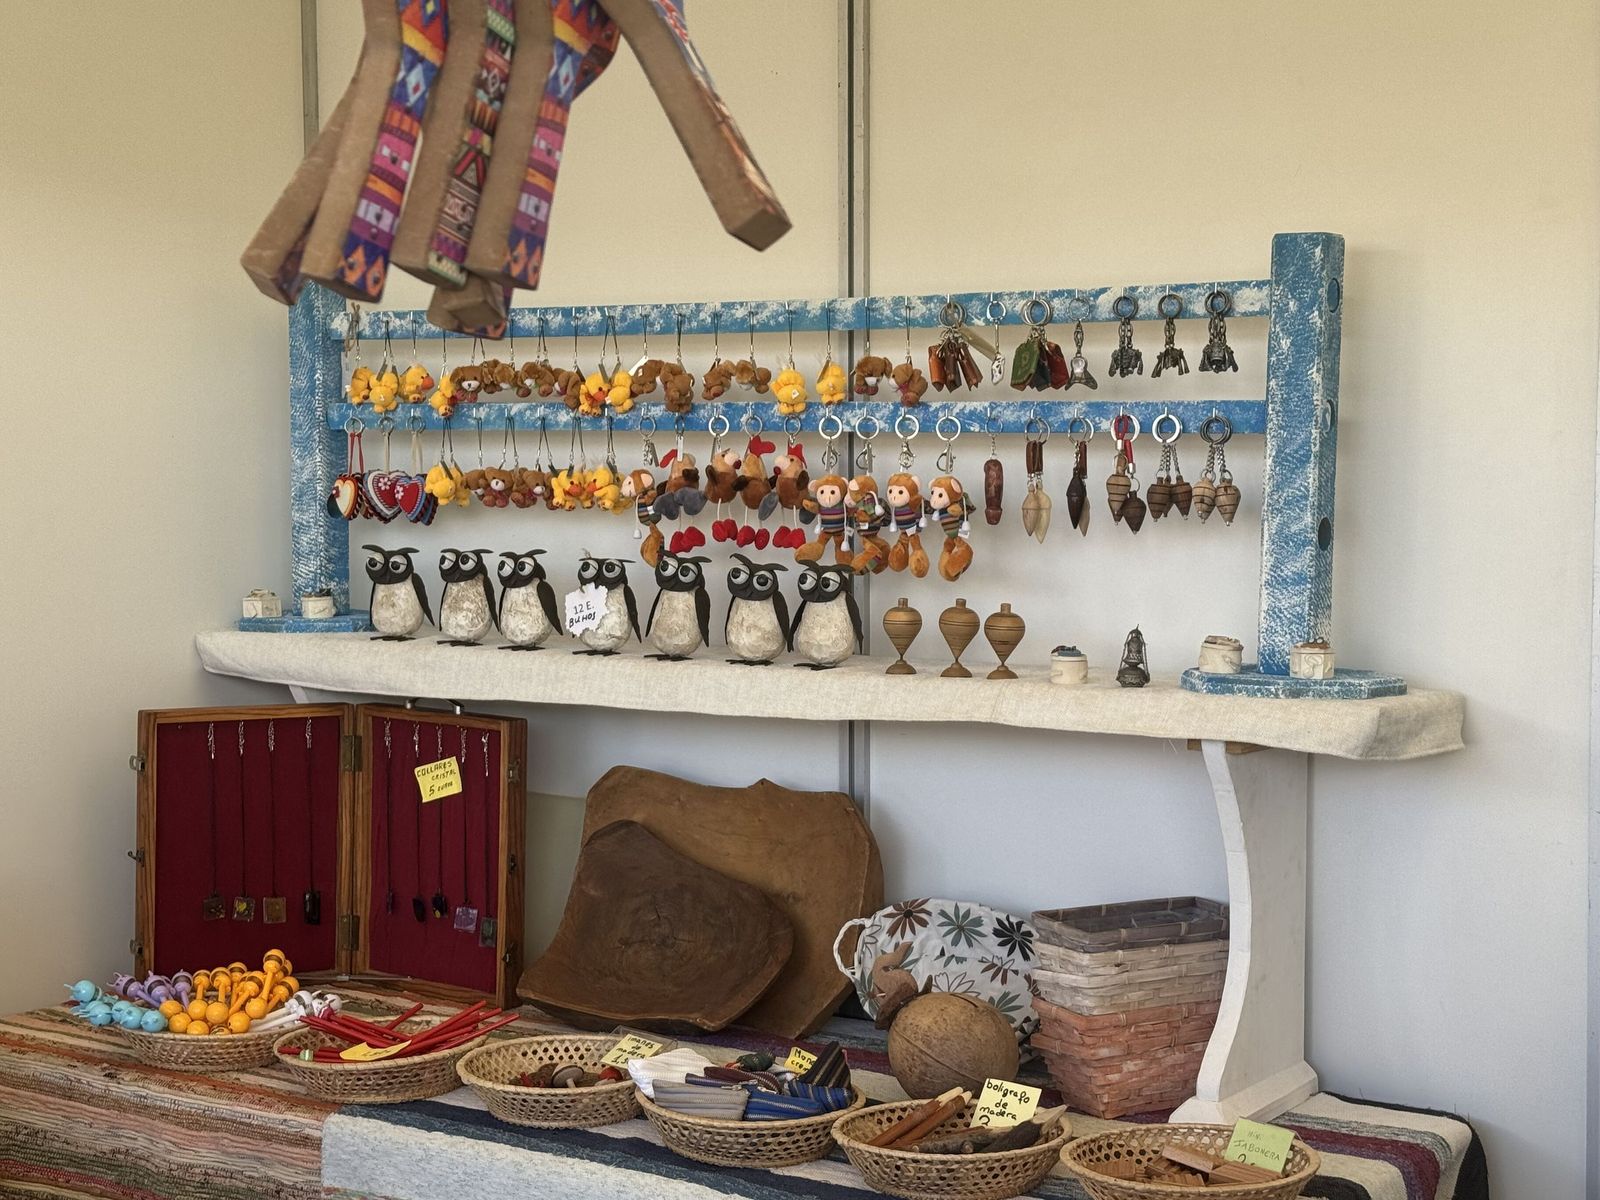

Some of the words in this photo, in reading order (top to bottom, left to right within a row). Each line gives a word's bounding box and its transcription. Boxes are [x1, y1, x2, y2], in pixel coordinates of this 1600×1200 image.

[573, 603, 584, 615] 12
[569, 611, 596, 628] BUHOS
[416, 760, 452, 777] COLLARES
[431, 768, 456, 780] CRISTAL
[428, 784, 435, 797] 5
[616, 1047, 646, 1059] madera
[994, 1098, 1009, 1110] de
[979, 1106, 1017, 1120] madera
